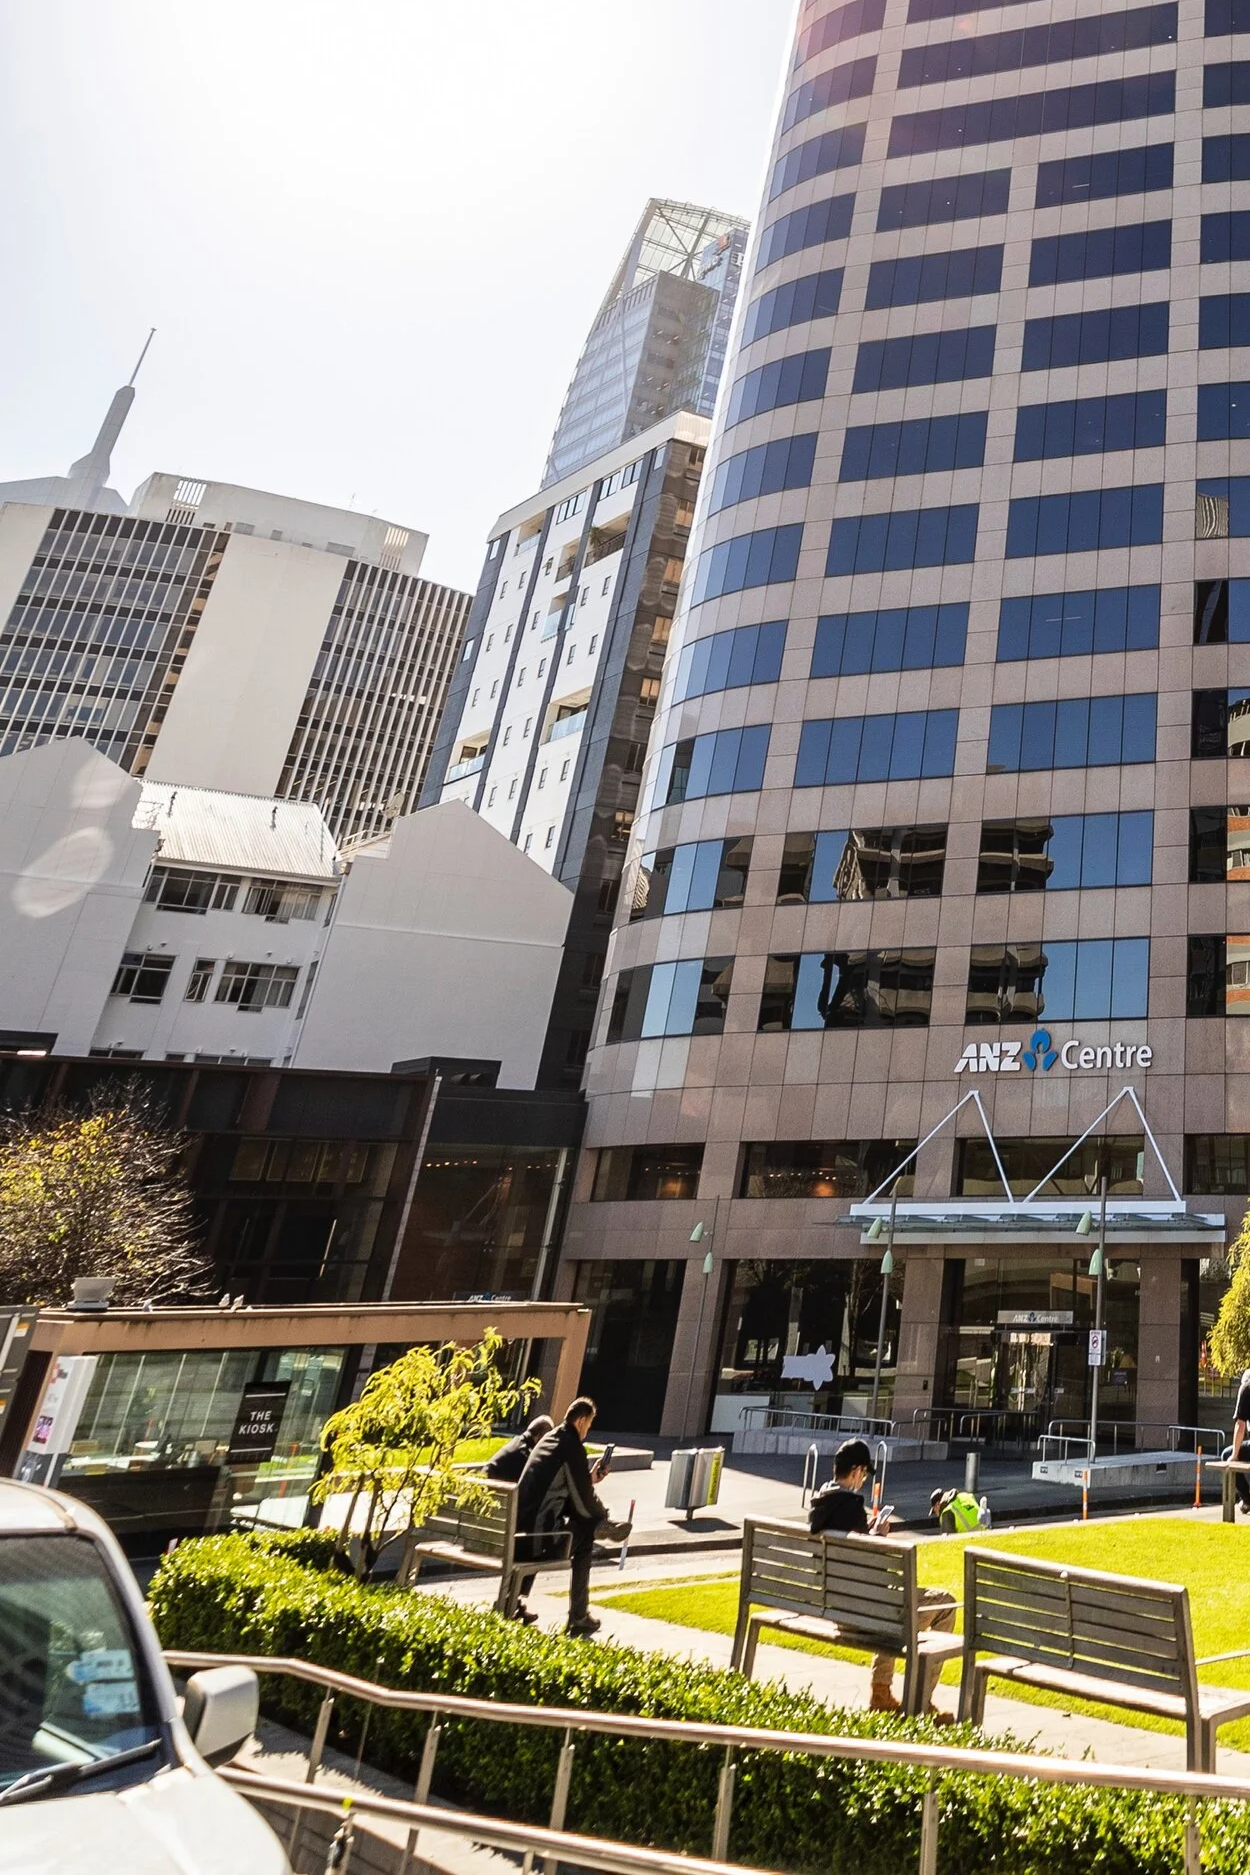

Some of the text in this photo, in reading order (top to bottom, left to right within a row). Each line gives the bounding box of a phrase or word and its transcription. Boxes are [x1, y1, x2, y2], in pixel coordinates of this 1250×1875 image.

[954, 1040, 1153, 1073] ANZ Centre
[490, 1293, 512, 1302] Centre
[1036, 1314, 1058, 1323] Centre
[250, 1410, 272, 1421] THE
